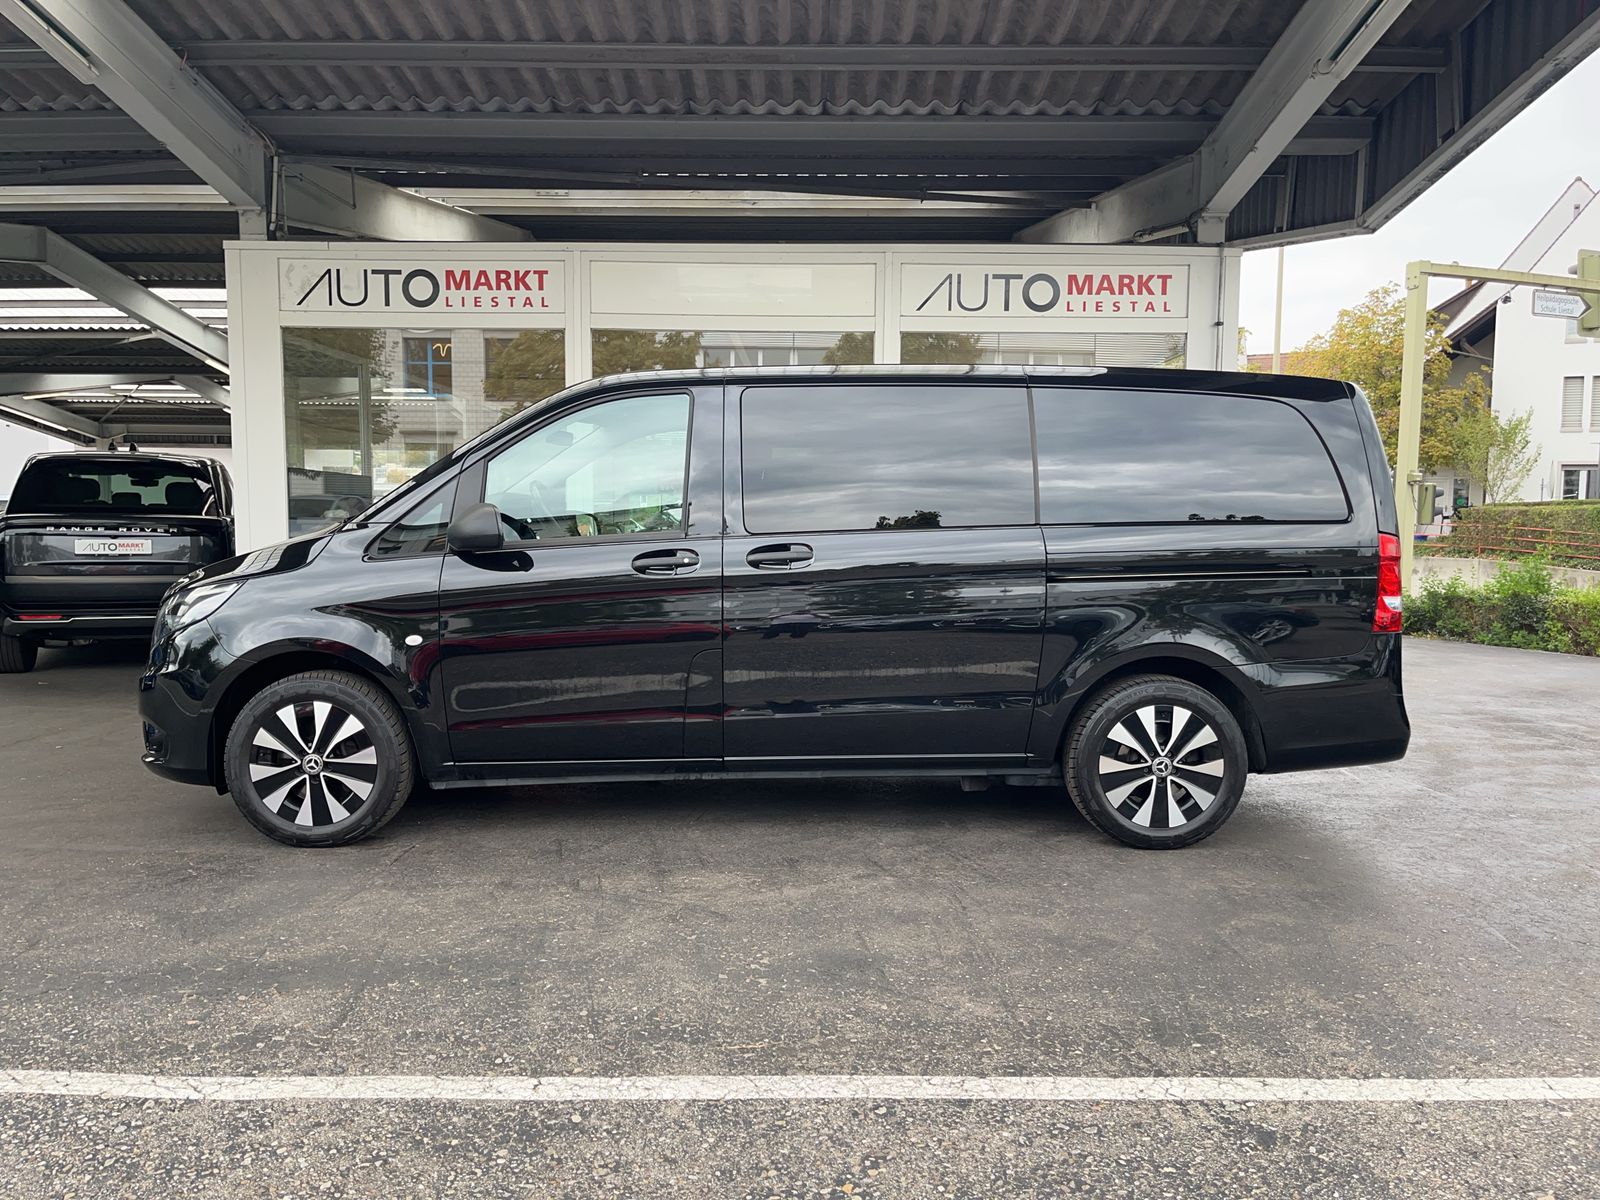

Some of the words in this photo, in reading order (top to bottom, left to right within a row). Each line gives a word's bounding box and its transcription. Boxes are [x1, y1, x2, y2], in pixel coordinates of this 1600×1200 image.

[296, 268, 440, 308] AUTO
[445, 269, 549, 291] MARKT
[915, 273, 1061, 313] AUTO
[1067, 274, 1173, 296] MARKT
[445, 296, 549, 308] LIESTAL
[1066, 301, 1171, 313] LIESTAL
[82, 543, 118, 552] AUTO
